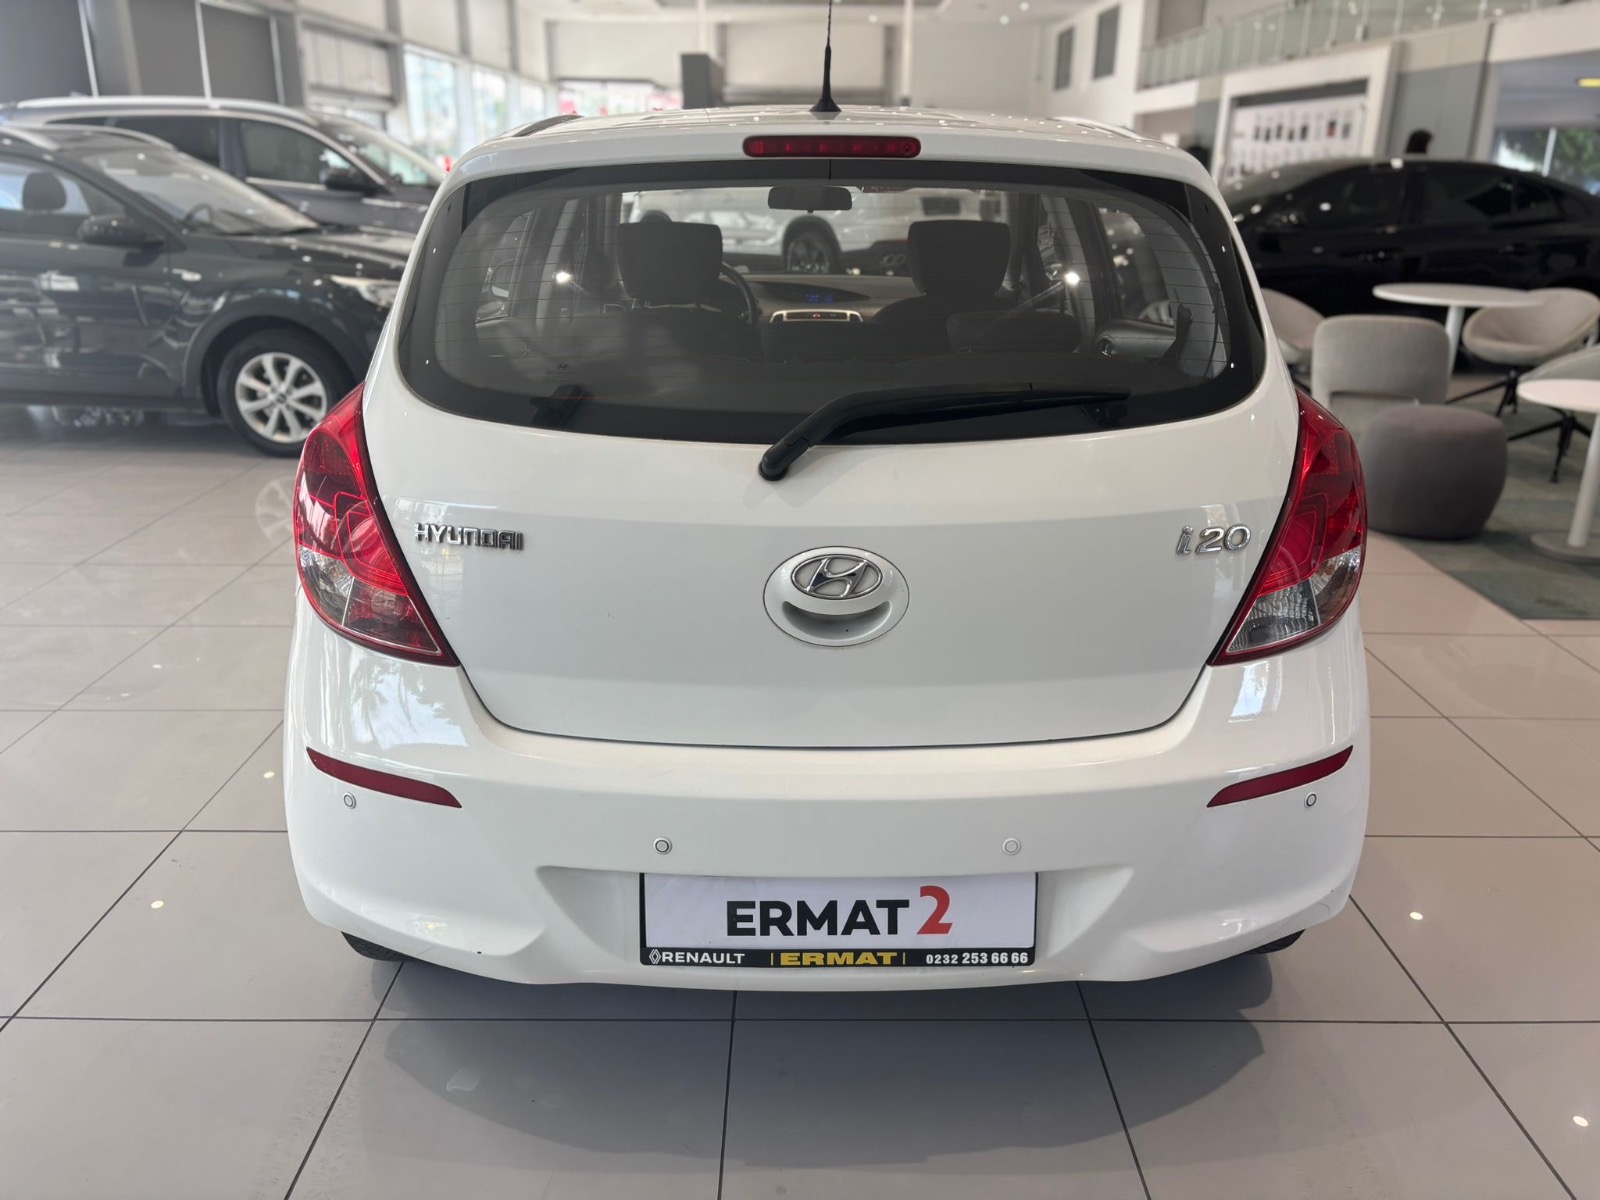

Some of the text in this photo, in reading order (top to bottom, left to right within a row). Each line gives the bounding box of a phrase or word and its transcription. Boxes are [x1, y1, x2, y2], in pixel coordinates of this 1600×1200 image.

[414, 522, 524, 550] HYUNDAI
[1176, 524, 1251, 555] i20
[727, 885, 953, 936] ERMAT 2
[662, 951, 1029, 966] RENAULT ERMAT 0232 253 66 66
